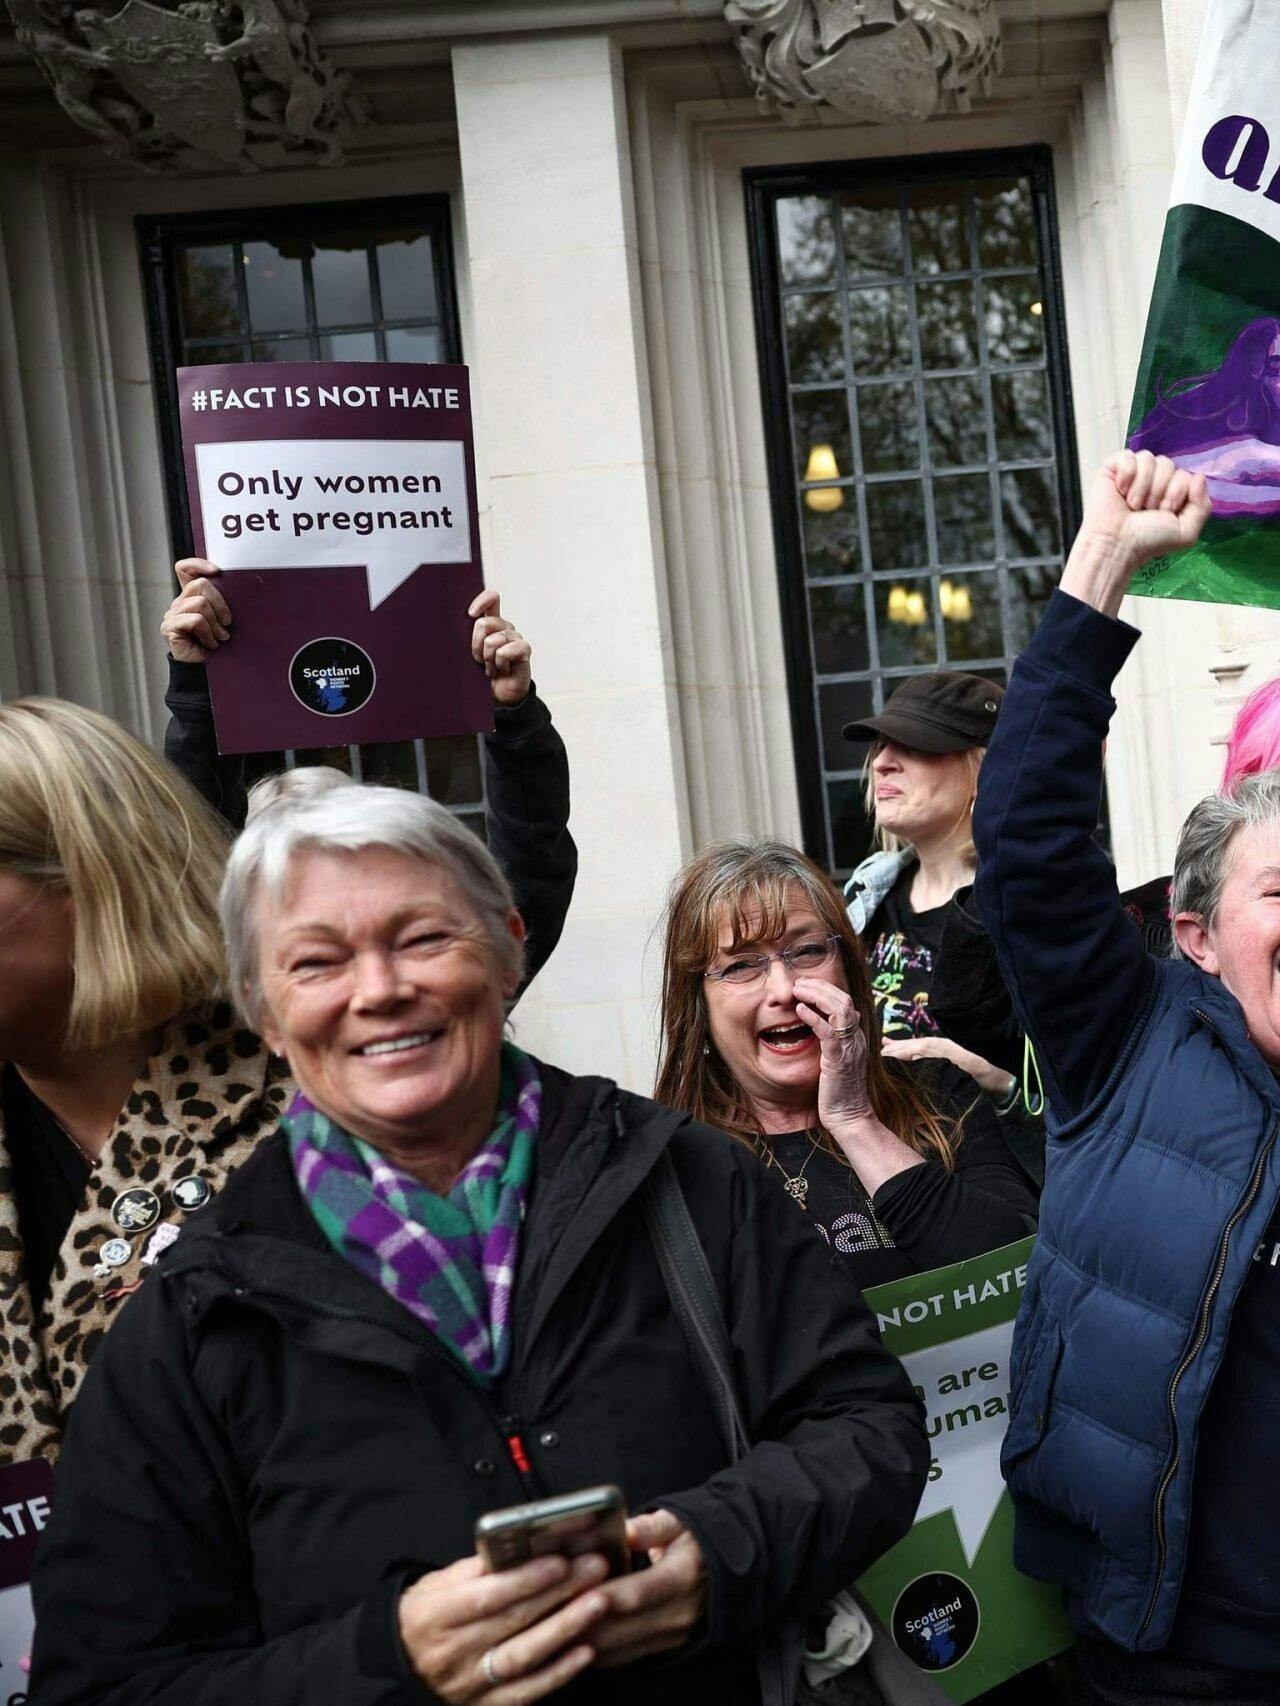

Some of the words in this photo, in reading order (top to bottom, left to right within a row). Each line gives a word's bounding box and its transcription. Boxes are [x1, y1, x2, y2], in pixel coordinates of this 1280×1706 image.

[192, 386, 277, 411] #FACT
[285, 386, 311, 408] IS
[318, 386, 381, 408] NOT
[389, 386, 460, 410] HATE
[217, 469, 303, 500] Only
[315, 472, 442, 494] women
[221, 508, 281, 538] get
[293, 506, 453, 536] pregnant
[303, 665, 360, 678] Scotland
[876, 1293, 944, 1333] NOT
[953, 1264, 1028, 1310] HATE
[938, 1361, 999, 1395] are
[926, 1392, 1012, 1439] uma
[905, 1597, 962, 1633] Scotland
